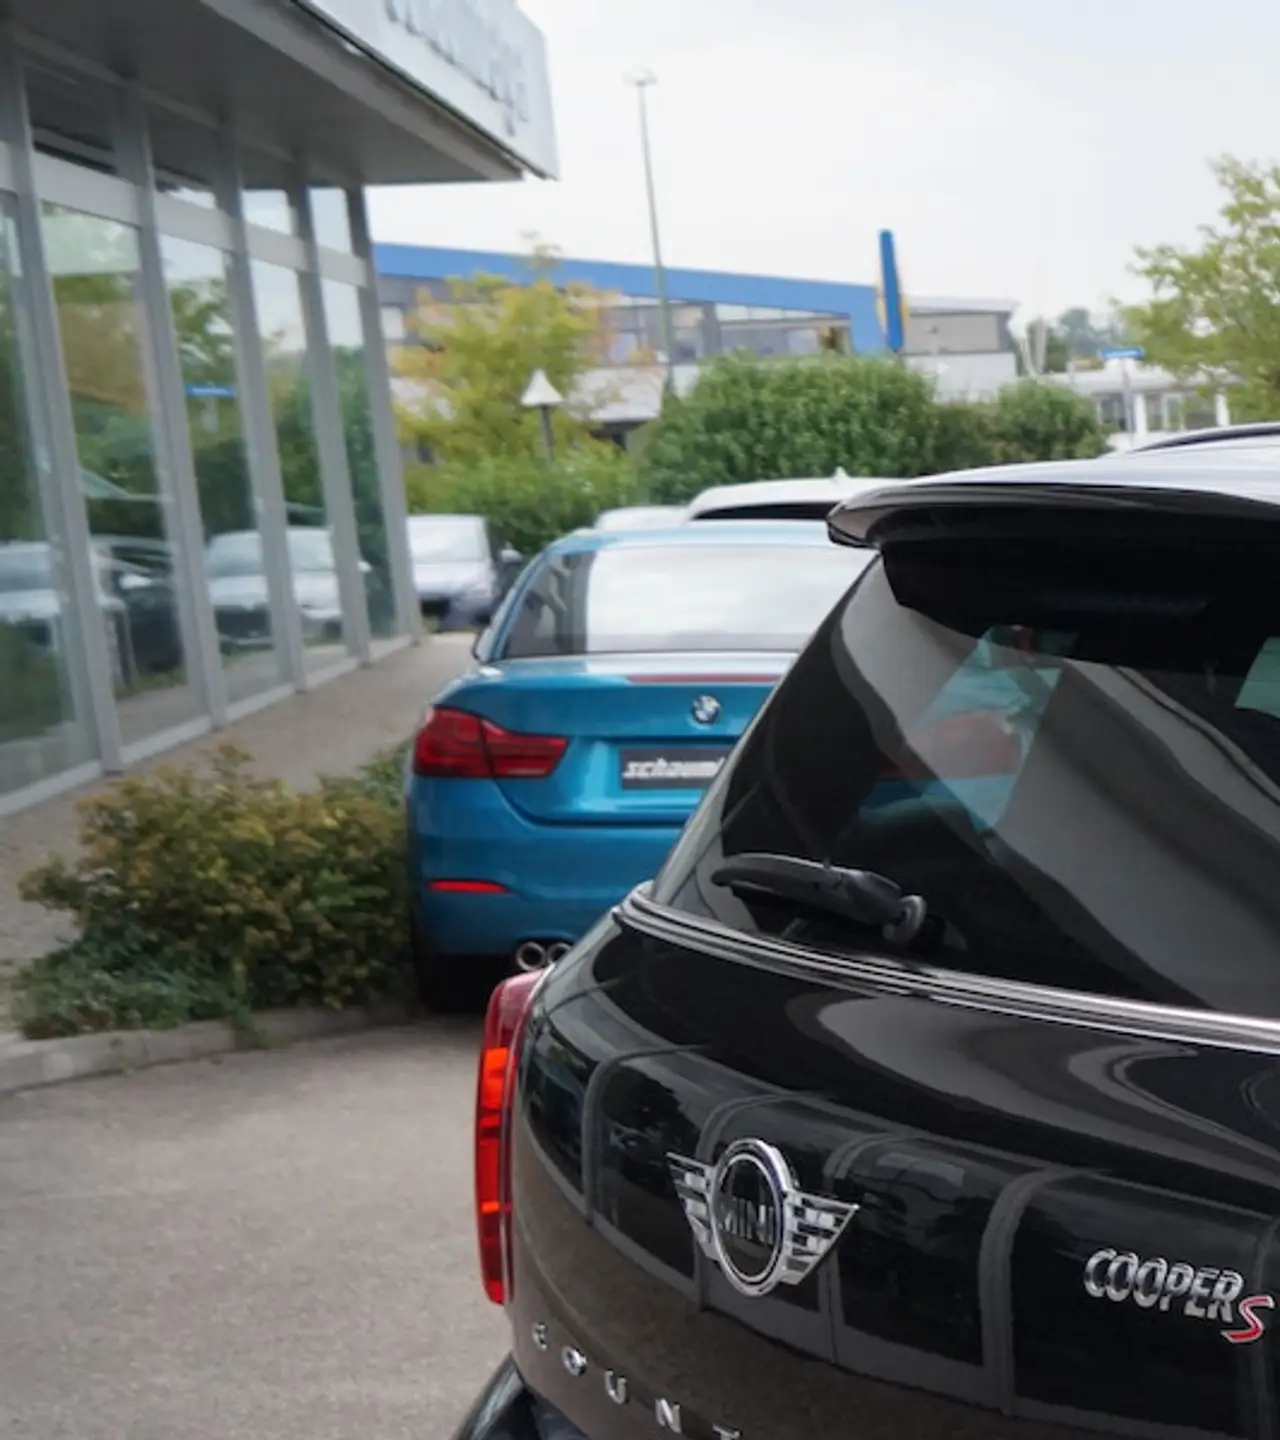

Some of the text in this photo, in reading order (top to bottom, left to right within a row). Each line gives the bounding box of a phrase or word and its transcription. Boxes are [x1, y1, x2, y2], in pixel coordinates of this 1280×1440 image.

[623, 757, 725, 779] schaum
[1084, 1248, 1275, 1343] COOPER S
